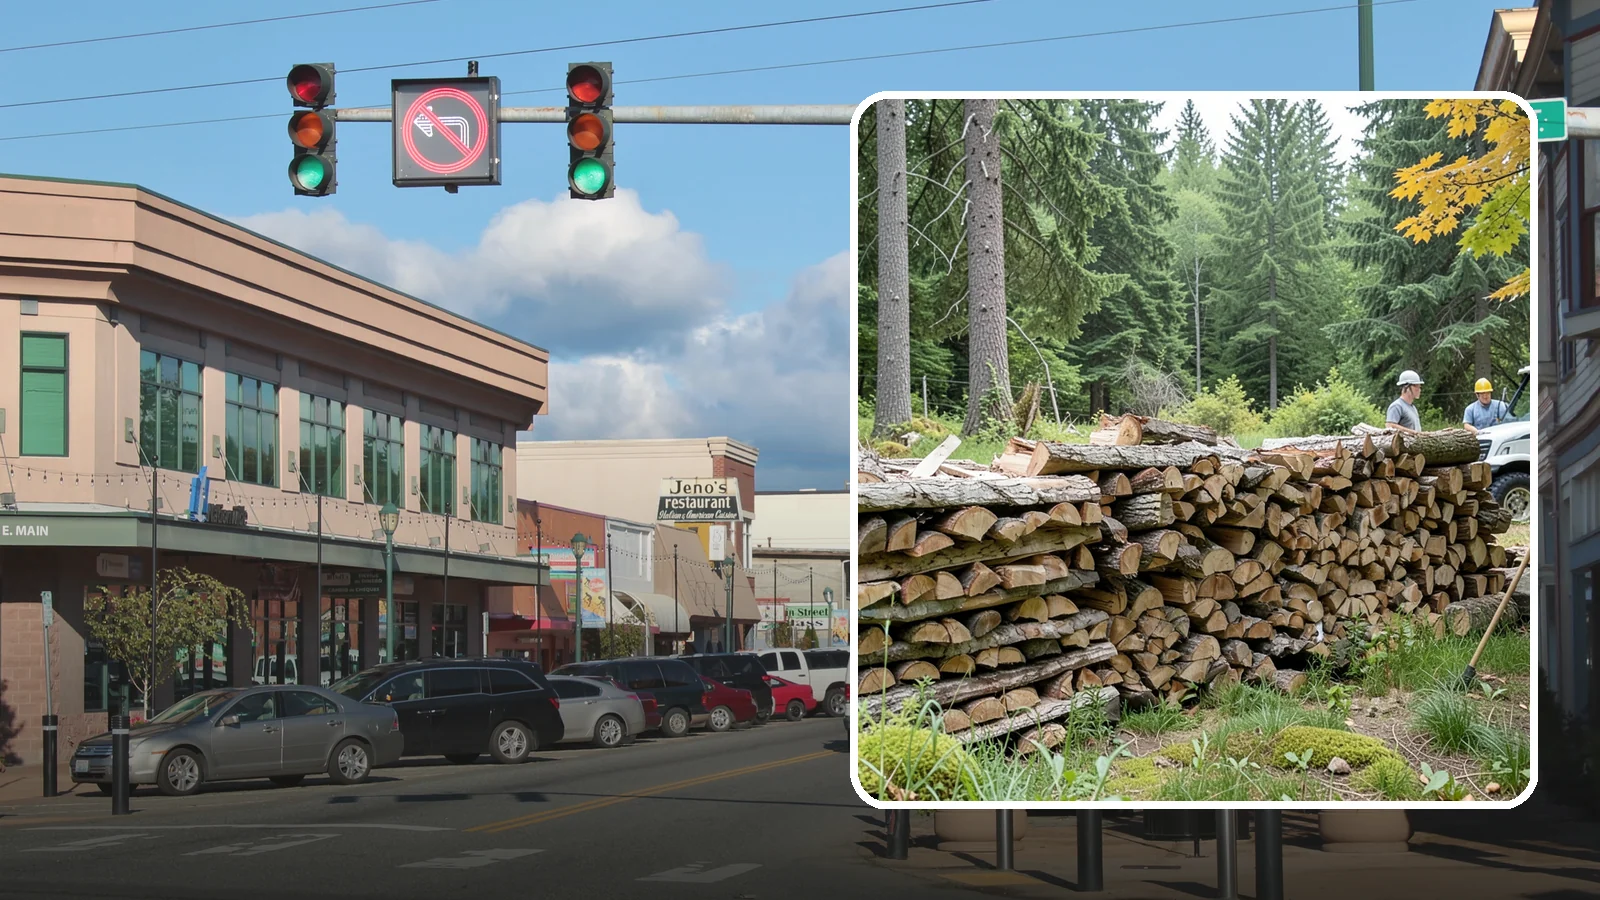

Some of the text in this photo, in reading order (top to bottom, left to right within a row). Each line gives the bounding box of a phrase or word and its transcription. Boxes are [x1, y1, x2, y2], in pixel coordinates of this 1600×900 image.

[669, 480, 727, 495] Jeno's
[664, 496, 731, 509] restaurant
[658, 510, 681, 519] Italian
[686, 510, 714, 519] American
[715, 510, 737, 519] Cuisine
[2, 525, 49, 536] E. MAIN
[797, 607, 829, 617] Street
